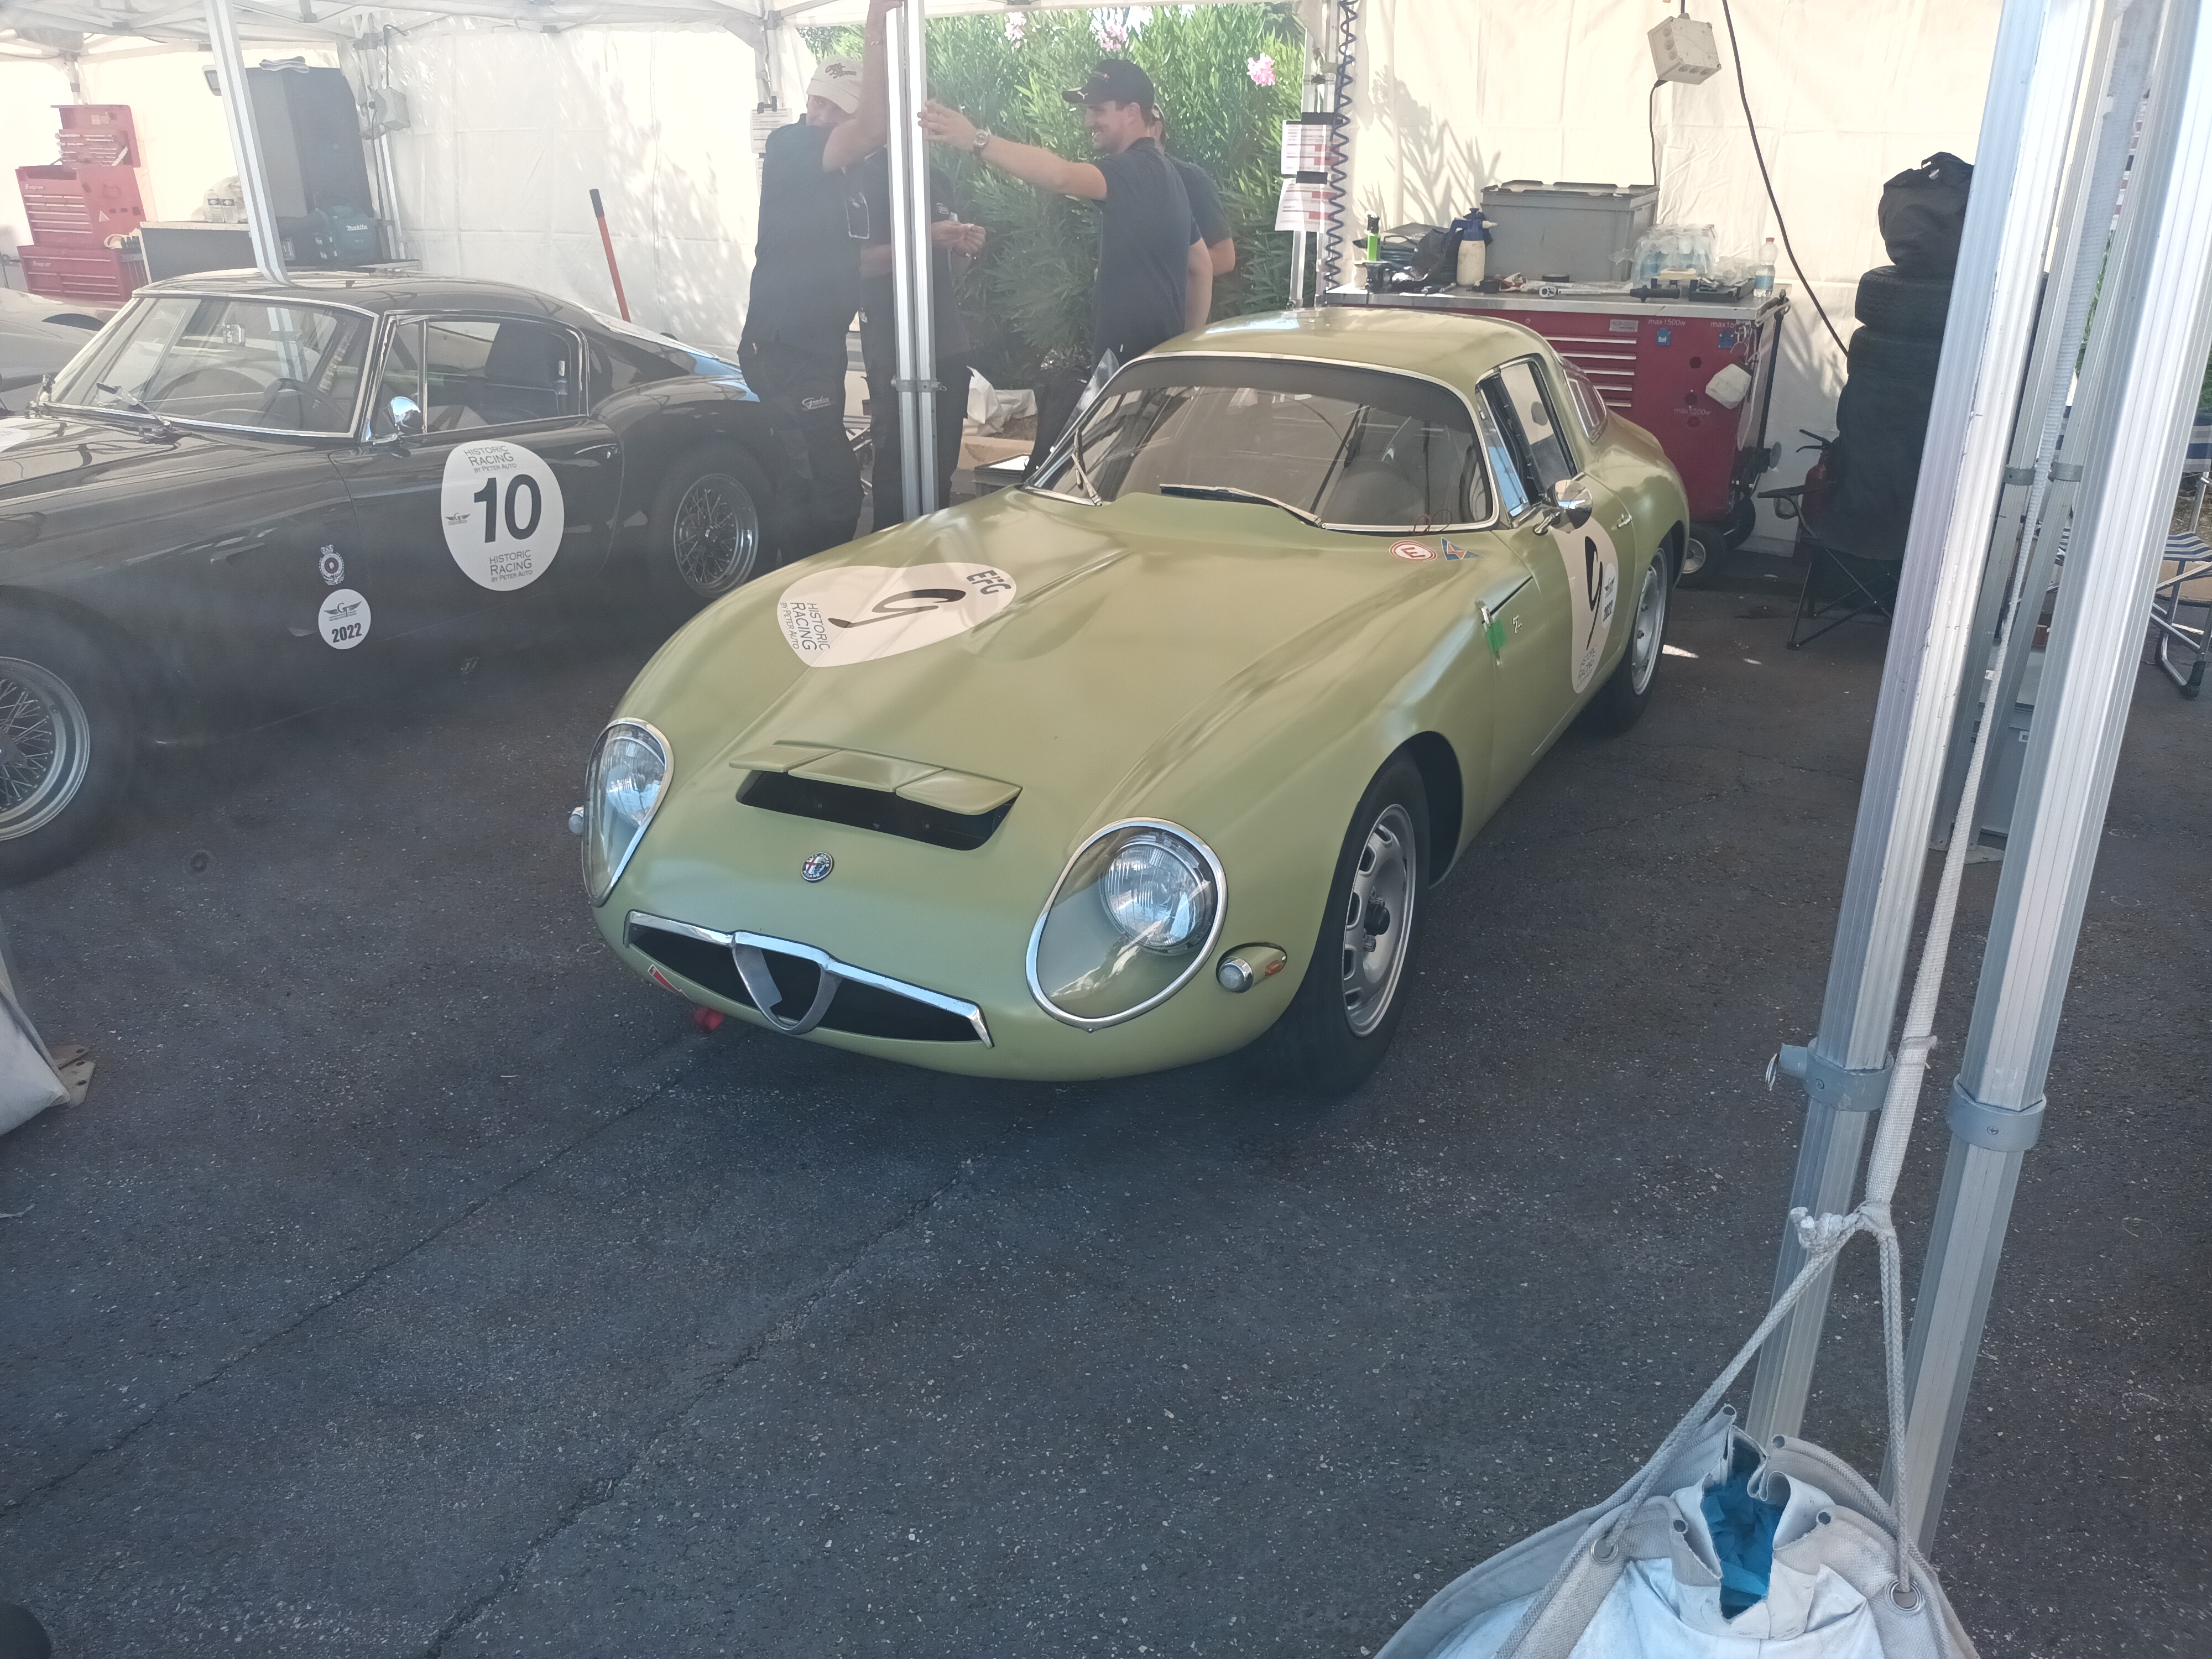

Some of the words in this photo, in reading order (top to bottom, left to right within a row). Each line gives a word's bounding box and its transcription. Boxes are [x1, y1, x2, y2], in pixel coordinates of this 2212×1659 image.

[463, 446, 508, 456] HISTORIC
[468, 452, 514, 466] RACING
[474, 474, 542, 544] 10
[489, 549, 531, 565] HISTORIC
[490, 558, 533, 576] RACING
[499, 572, 517, 581] PETER
[828, 588, 966, 629] 9
[1584, 536, 1603, 651] 9
[332, 622, 362, 643] 2022
[782, 610, 795, 629] PETER
[789, 630, 800, 649] AUTO
[790, 602, 817, 650] RACING
[806, 603, 831, 650] HISTORIC
